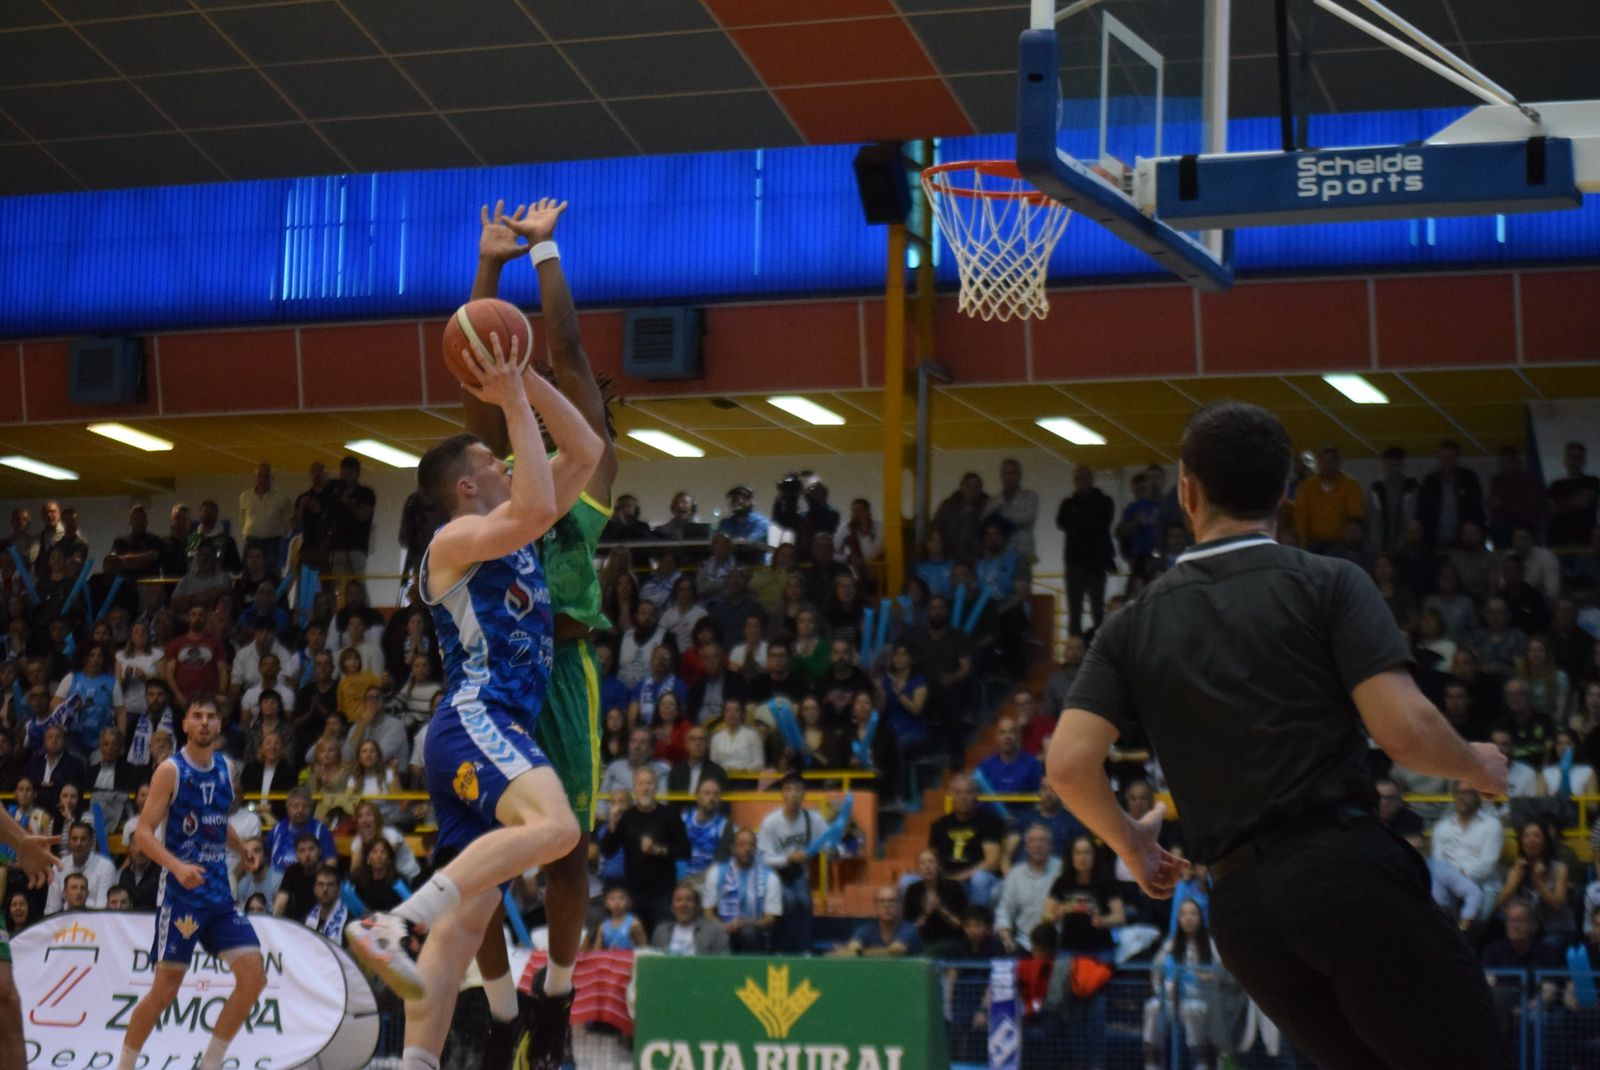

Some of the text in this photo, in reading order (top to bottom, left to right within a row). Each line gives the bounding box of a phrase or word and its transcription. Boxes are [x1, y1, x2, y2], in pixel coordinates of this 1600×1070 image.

[1297, 153, 1424, 177] Schelde
[1297, 174, 1424, 201] Sports
[199, 782, 216, 805] 17
[105, 993, 283, 1034] ZMORA
